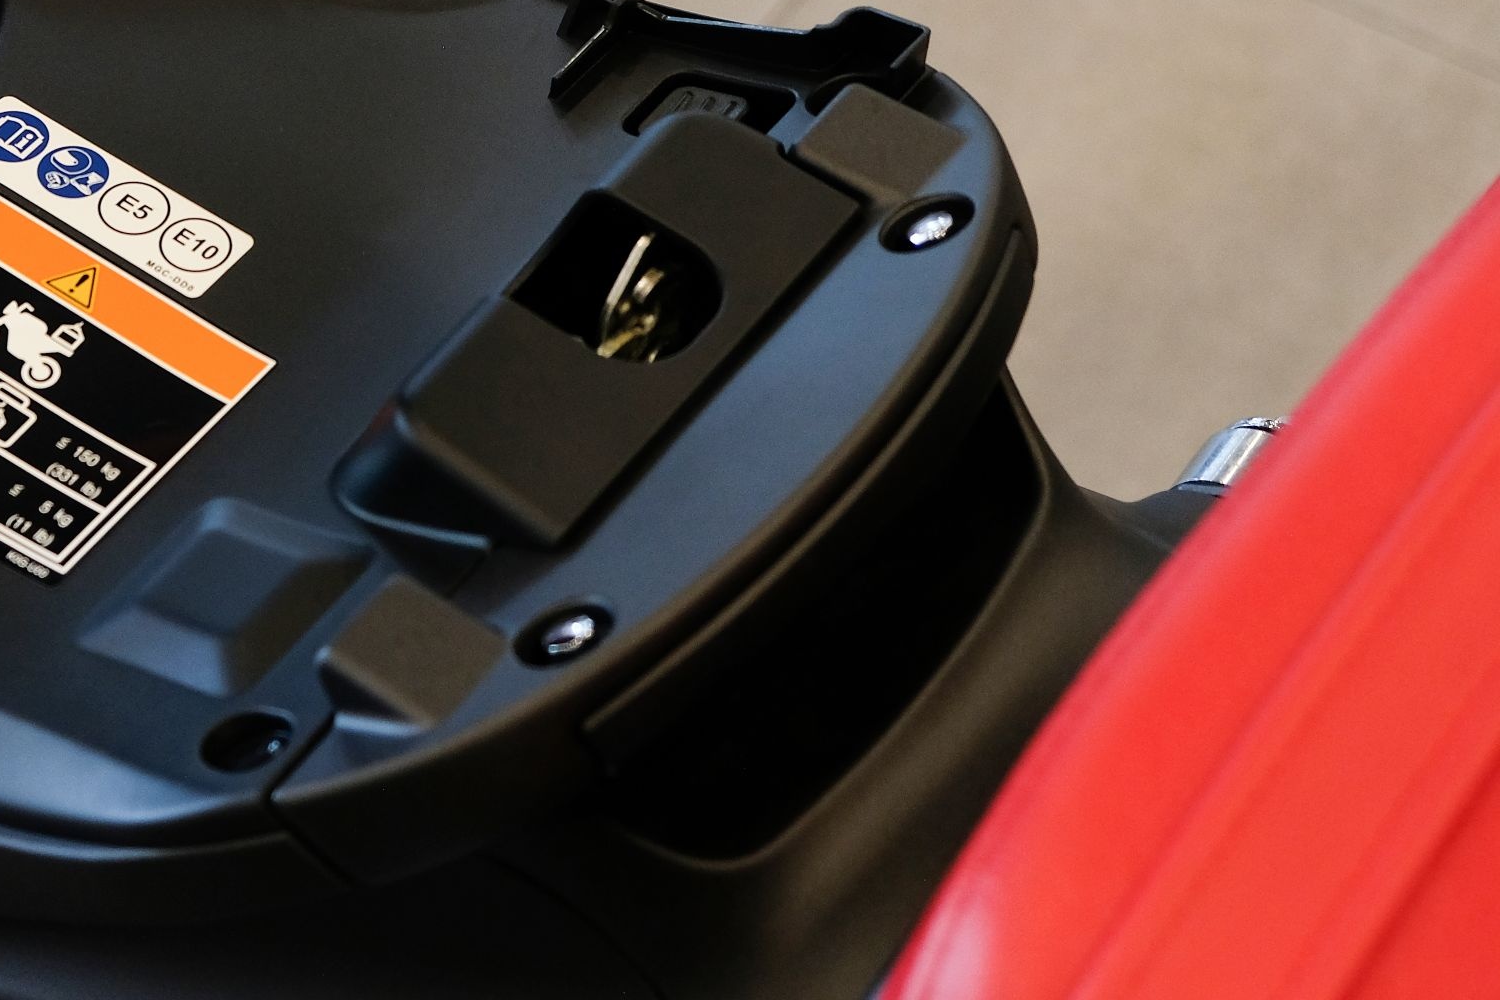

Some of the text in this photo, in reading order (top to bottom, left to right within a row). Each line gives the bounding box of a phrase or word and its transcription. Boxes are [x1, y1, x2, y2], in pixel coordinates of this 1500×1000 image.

[116, 194, 219, 260] E5 E10
[45, 462, 102, 500] (331 lb)
[73, 446, 101, 467] 150
[100, 461, 121, 481] kg
[5, 513, 55, 547] (11 lb)
[53, 508, 74, 528] kg
